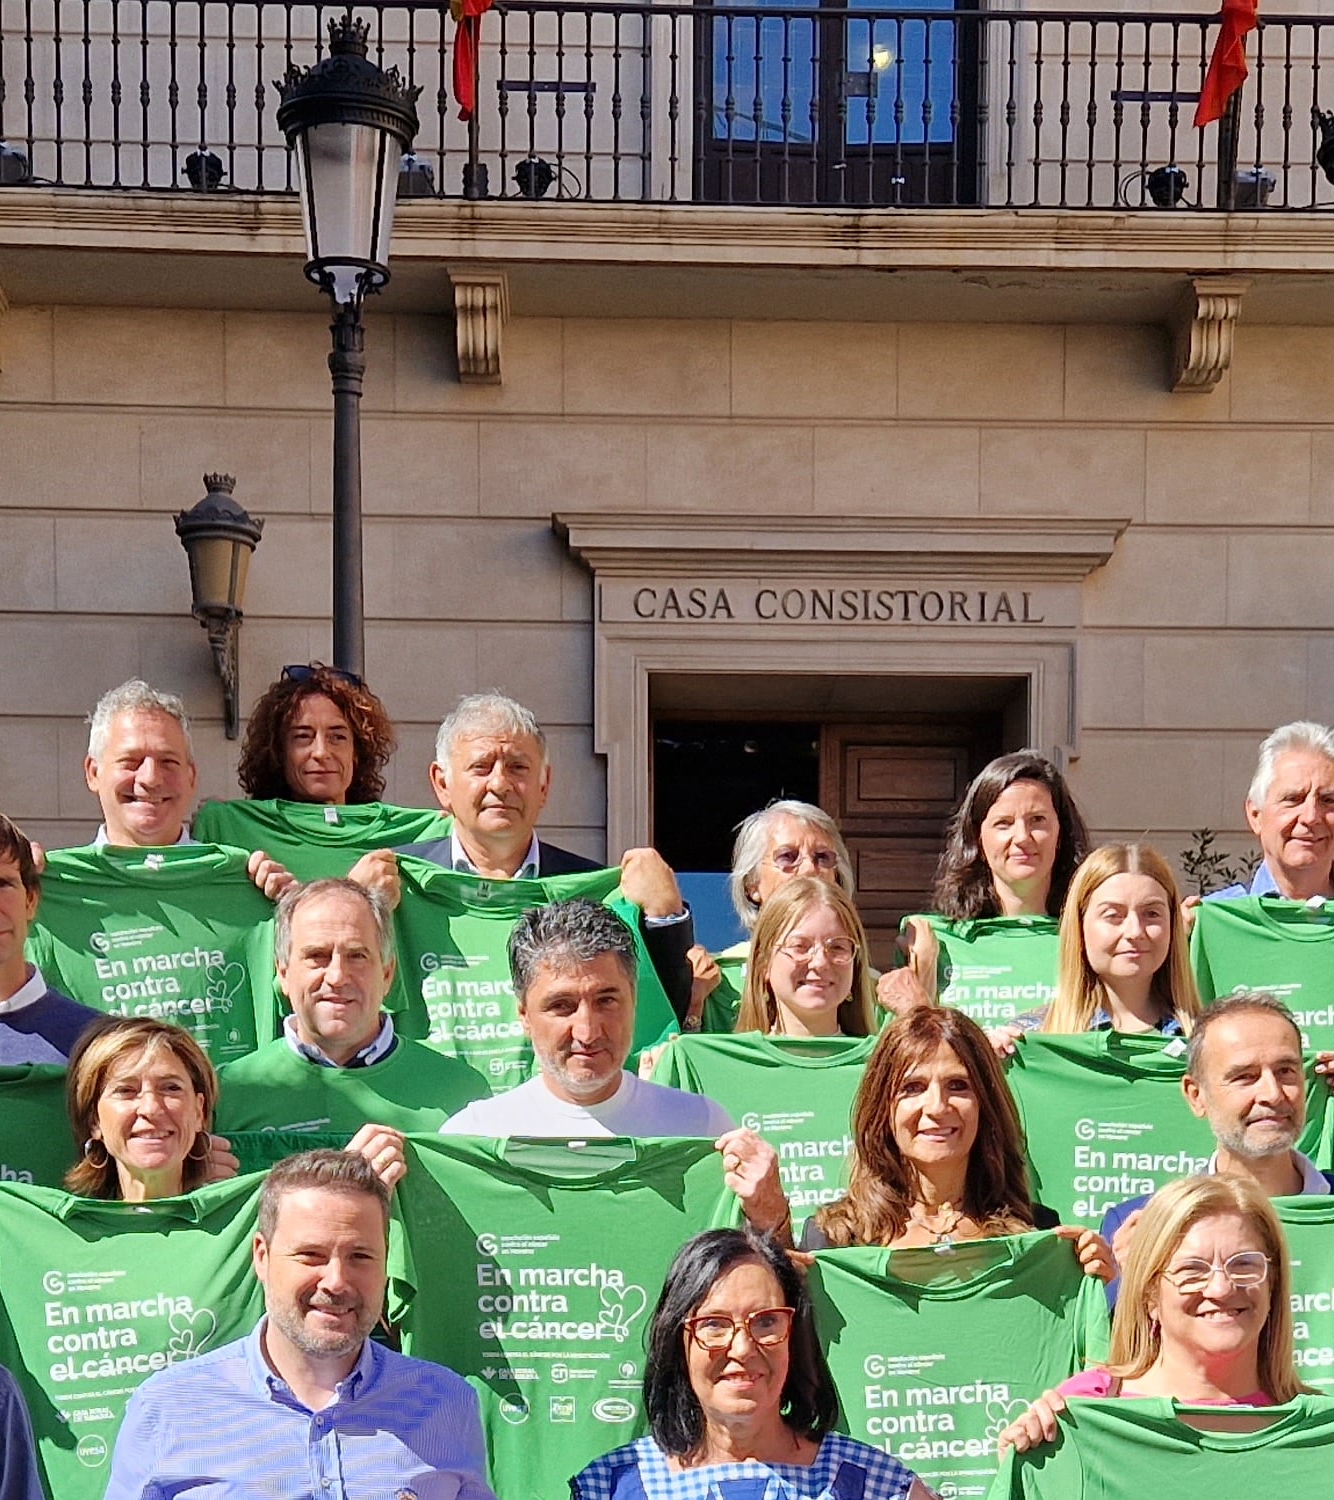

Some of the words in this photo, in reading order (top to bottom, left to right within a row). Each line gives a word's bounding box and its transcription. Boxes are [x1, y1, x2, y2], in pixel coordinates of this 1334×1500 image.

[633, 587, 735, 619] CASA
[755, 588, 1045, 622] CONSISTORIAL
[95, 958, 127, 979] En
[132, 946, 225, 974] marcha
[102, 975, 180, 1001] contra
[422, 976, 451, 998] En
[453, 1020, 524, 1041] cánce
[780, 1135, 855, 1159] march
[1074, 1145, 1105, 1169] En
[779, 1162, 824, 1183] ntra
[1073, 1172, 1155, 1194] contra
[1072, 1195, 1095, 1217] el
[477, 1263, 511, 1286] En
[519, 1263, 624, 1287] marcha
[44, 1301, 79, 1327] En
[86, 1292, 194, 1322] marcha
[477, 1289, 568, 1313] contra
[47, 1326, 138, 1354] contra
[479, 1317, 504, 1340] el
[511, 1315, 604, 1341] cáncer
[49, 1356, 73, 1382] el
[82, 1351, 178, 1378] cáncer
[865, 1384, 898, 1409] En
[906, 1380, 1010, 1406] marcha
[866, 1409, 955, 1436] contra
[900, 1436, 992, 1461] cáncer
